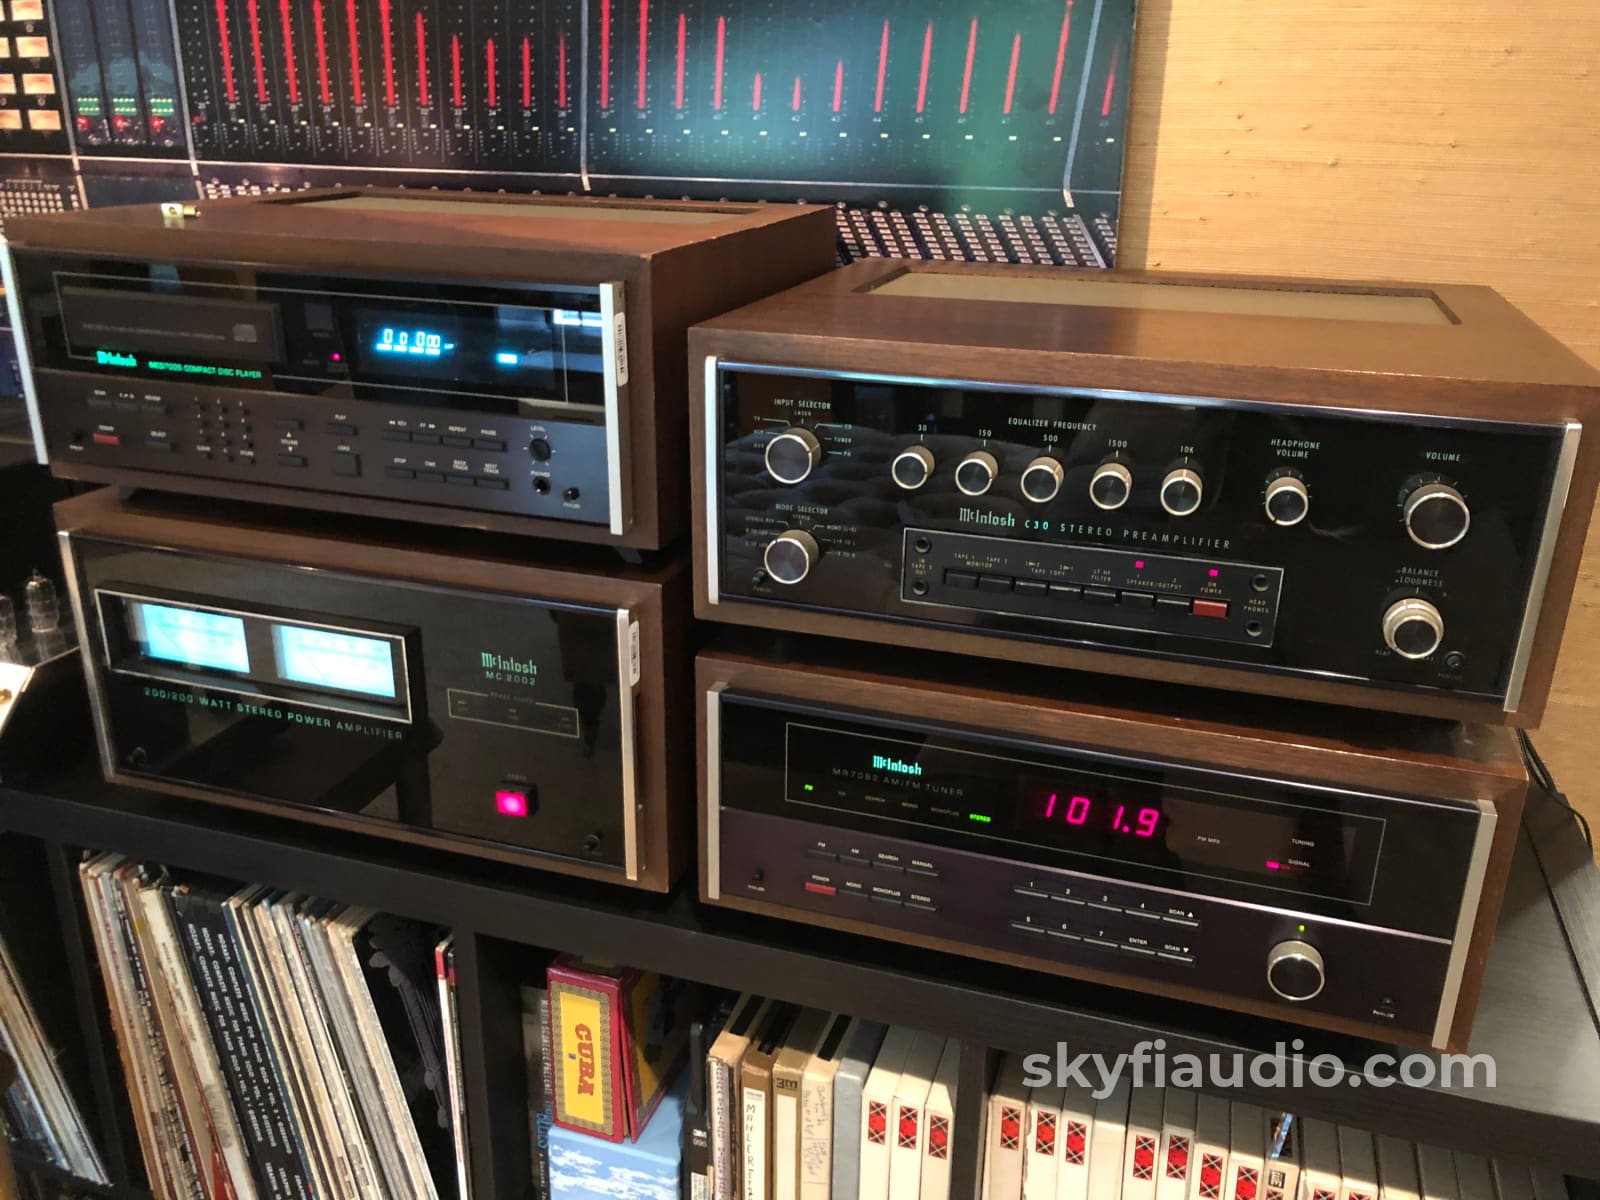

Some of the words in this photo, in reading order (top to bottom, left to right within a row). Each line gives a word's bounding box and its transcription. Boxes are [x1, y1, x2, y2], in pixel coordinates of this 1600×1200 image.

[218, 368, 233, 376] DISC
[235, 369, 261, 378] PLAYER
[798, 400, 831, 410] SELECTOR
[918, 424, 928, 432] 30
[1008, 417, 1049, 428] EQUALIZER
[1053, 420, 1096, 431] FREQUENCY
[1043, 434, 1058, 443] 500
[1108, 440, 1128, 448] 1500
[1180, 445, 1195, 454] 10K
[1271, 439, 1320, 450] HEADPHONE
[1276, 449, 1310, 459] VOLUME
[1426, 452, 1461, 462] VOLUME
[798, 506, 828, 514] SELECTOR
[960, 508, 1015, 527] McIntosh
[1060, 523, 1112, 537] STEREO
[1123, 530, 1230, 548] PREAMPLIFIER
[1402, 566, 1439, 577] BALANCE
[1400, 576, 1444, 587] LOUDNESS
[1243, 605, 1269, 614] PHONES
[481, 652, 537, 675] McIntosh
[486, 670, 502, 681] MC
[506, 674, 536, 686] 2002
[144, 687, 194, 704] 200/200
[199, 697, 232, 711] WATT
[237, 703, 282, 720] STEREO
[287, 712, 331, 729] POWER
[336, 721, 403, 740] AMPLIFIER
[873, 755, 922, 775] McIntosh
[883, 776, 921, 789] AM/FM
[926, 784, 964, 796] TUNER
[1045, 794, 1160, 837] 101.9
[1292, 838, 1315, 847] TUNING
[910, 894, 931, 902] STEREO
[199, 956, 214, 988] COMPLETE
[224, 1031, 234, 1051] PIANO
[212, 960, 227, 992] COMPLETE
[238, 1036, 248, 1056] PIANO
[228, 966, 242, 998] COMPLETE
[252, 1042, 262, 1063] PIANO
[575, 1023, 595, 1095] CUBA
